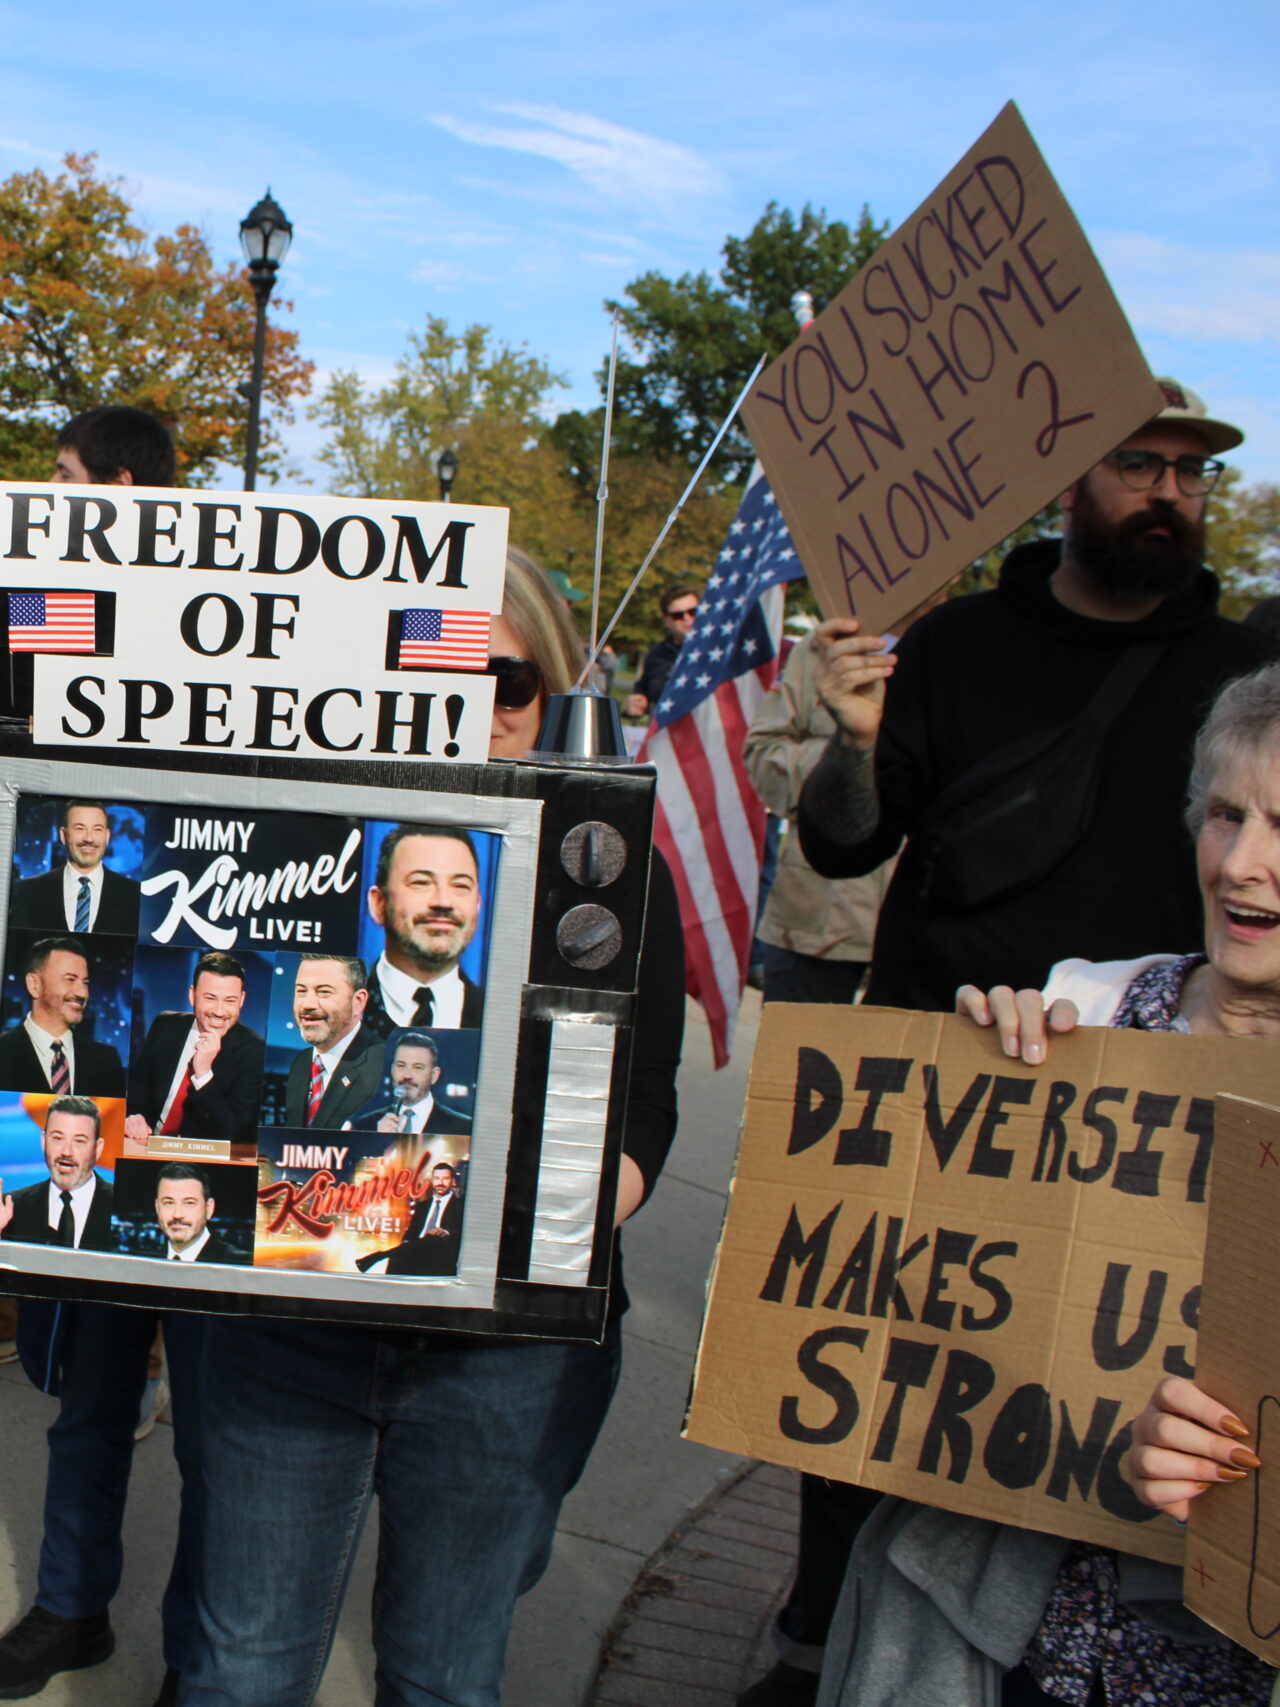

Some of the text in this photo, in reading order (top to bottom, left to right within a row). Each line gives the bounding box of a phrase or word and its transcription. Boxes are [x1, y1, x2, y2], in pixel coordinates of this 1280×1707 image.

[756, 155, 1025, 442] YOU SUCKED
[809, 218, 1082, 502] IN HOME
[835, 360, 1094, 616] ALONE 2
[3, 492, 476, 588] FREEDOM
[179, 591, 300, 659] OF
[60, 675, 467, 759] SPEECH!
[164, 817, 256, 853] JIMMY
[140, 828, 362, 950] Kimmel
[249, 917, 322, 943] LIVE!
[161, 1141, 216, 1152] JIMMY KIMMEL
[275, 1144, 350, 1170] JIMMY
[787, 1046, 1215, 1202] DIVERSIT
[257, 1151, 431, 1240] Kimmel
[344, 1215, 401, 1233] LIVE!
[759, 1200, 1018, 1331] MAKES
